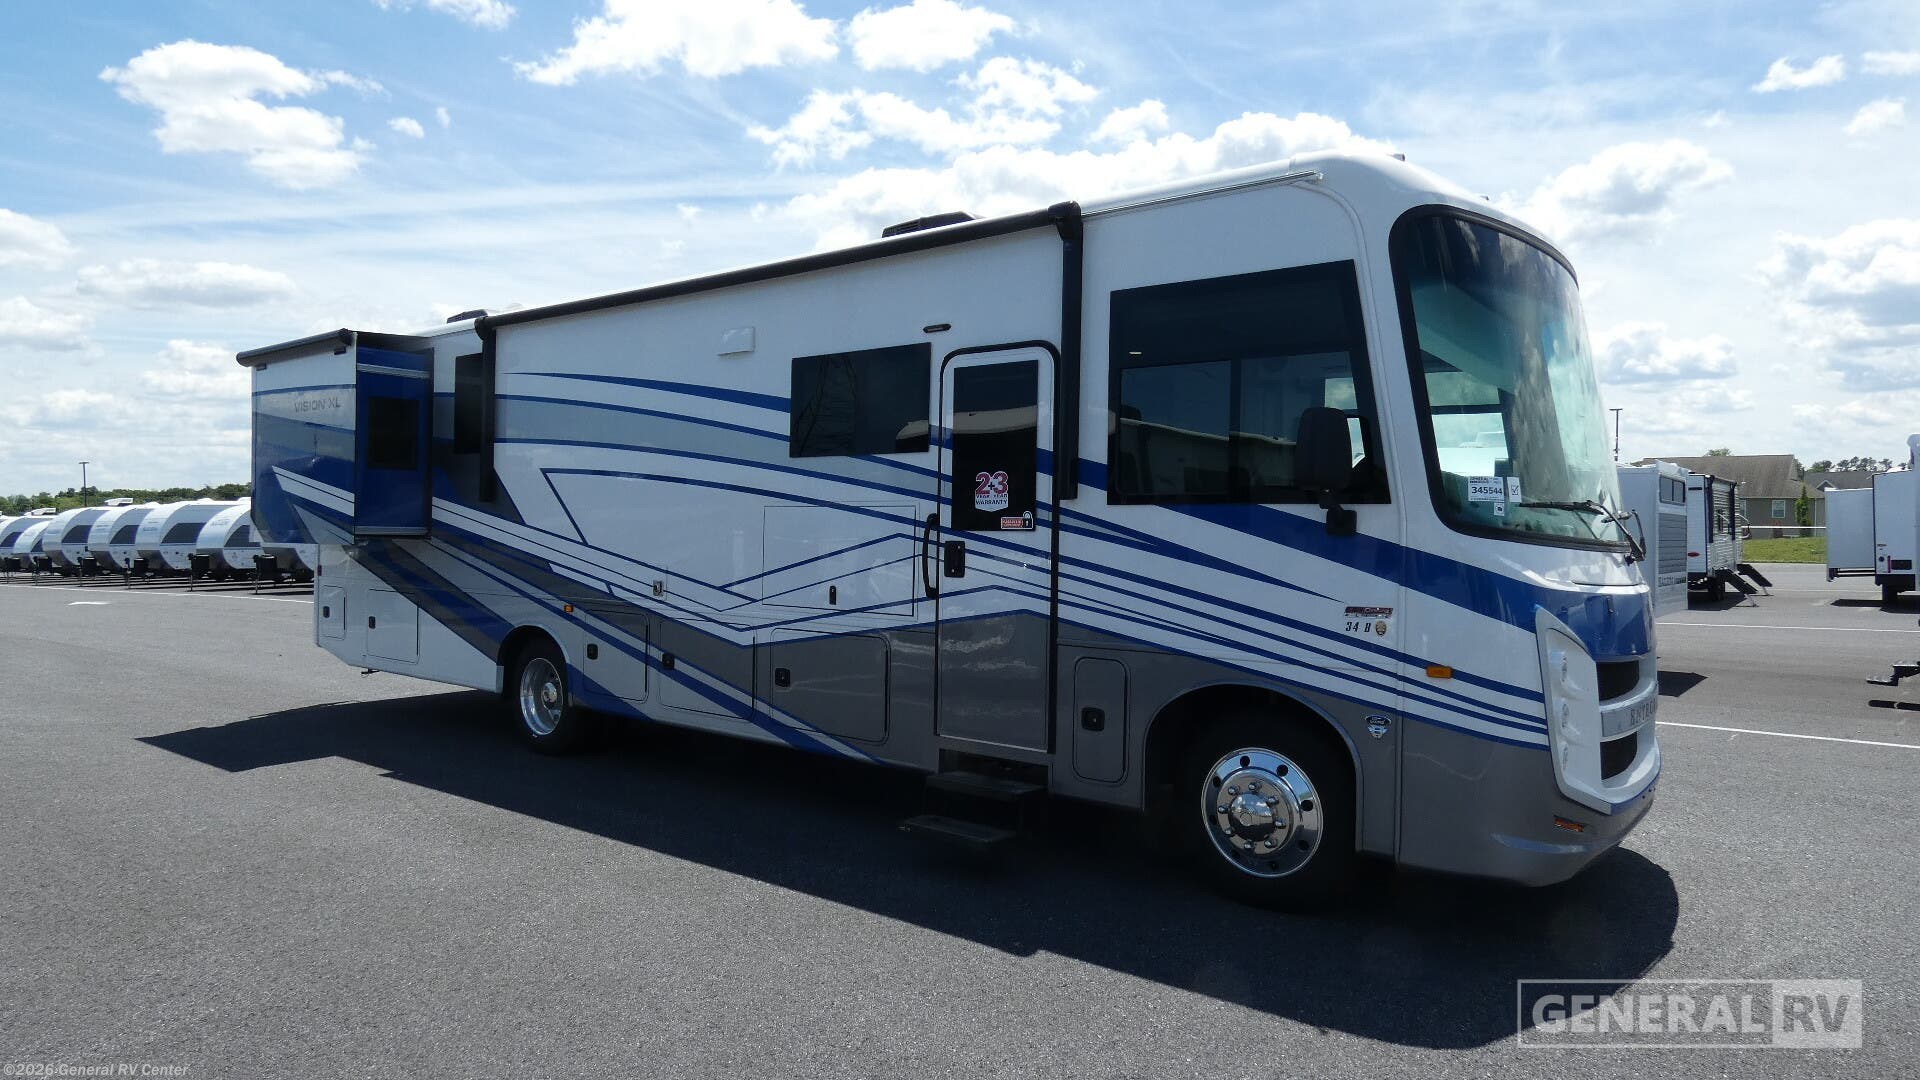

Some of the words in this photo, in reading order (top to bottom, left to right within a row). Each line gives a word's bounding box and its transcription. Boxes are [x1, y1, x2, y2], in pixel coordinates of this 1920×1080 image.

[294, 399, 325, 413] VISION
[328, 396, 341, 409] XL
[1471, 486, 1503, 495] 345544
[1345, 621, 1360, 633] 34
